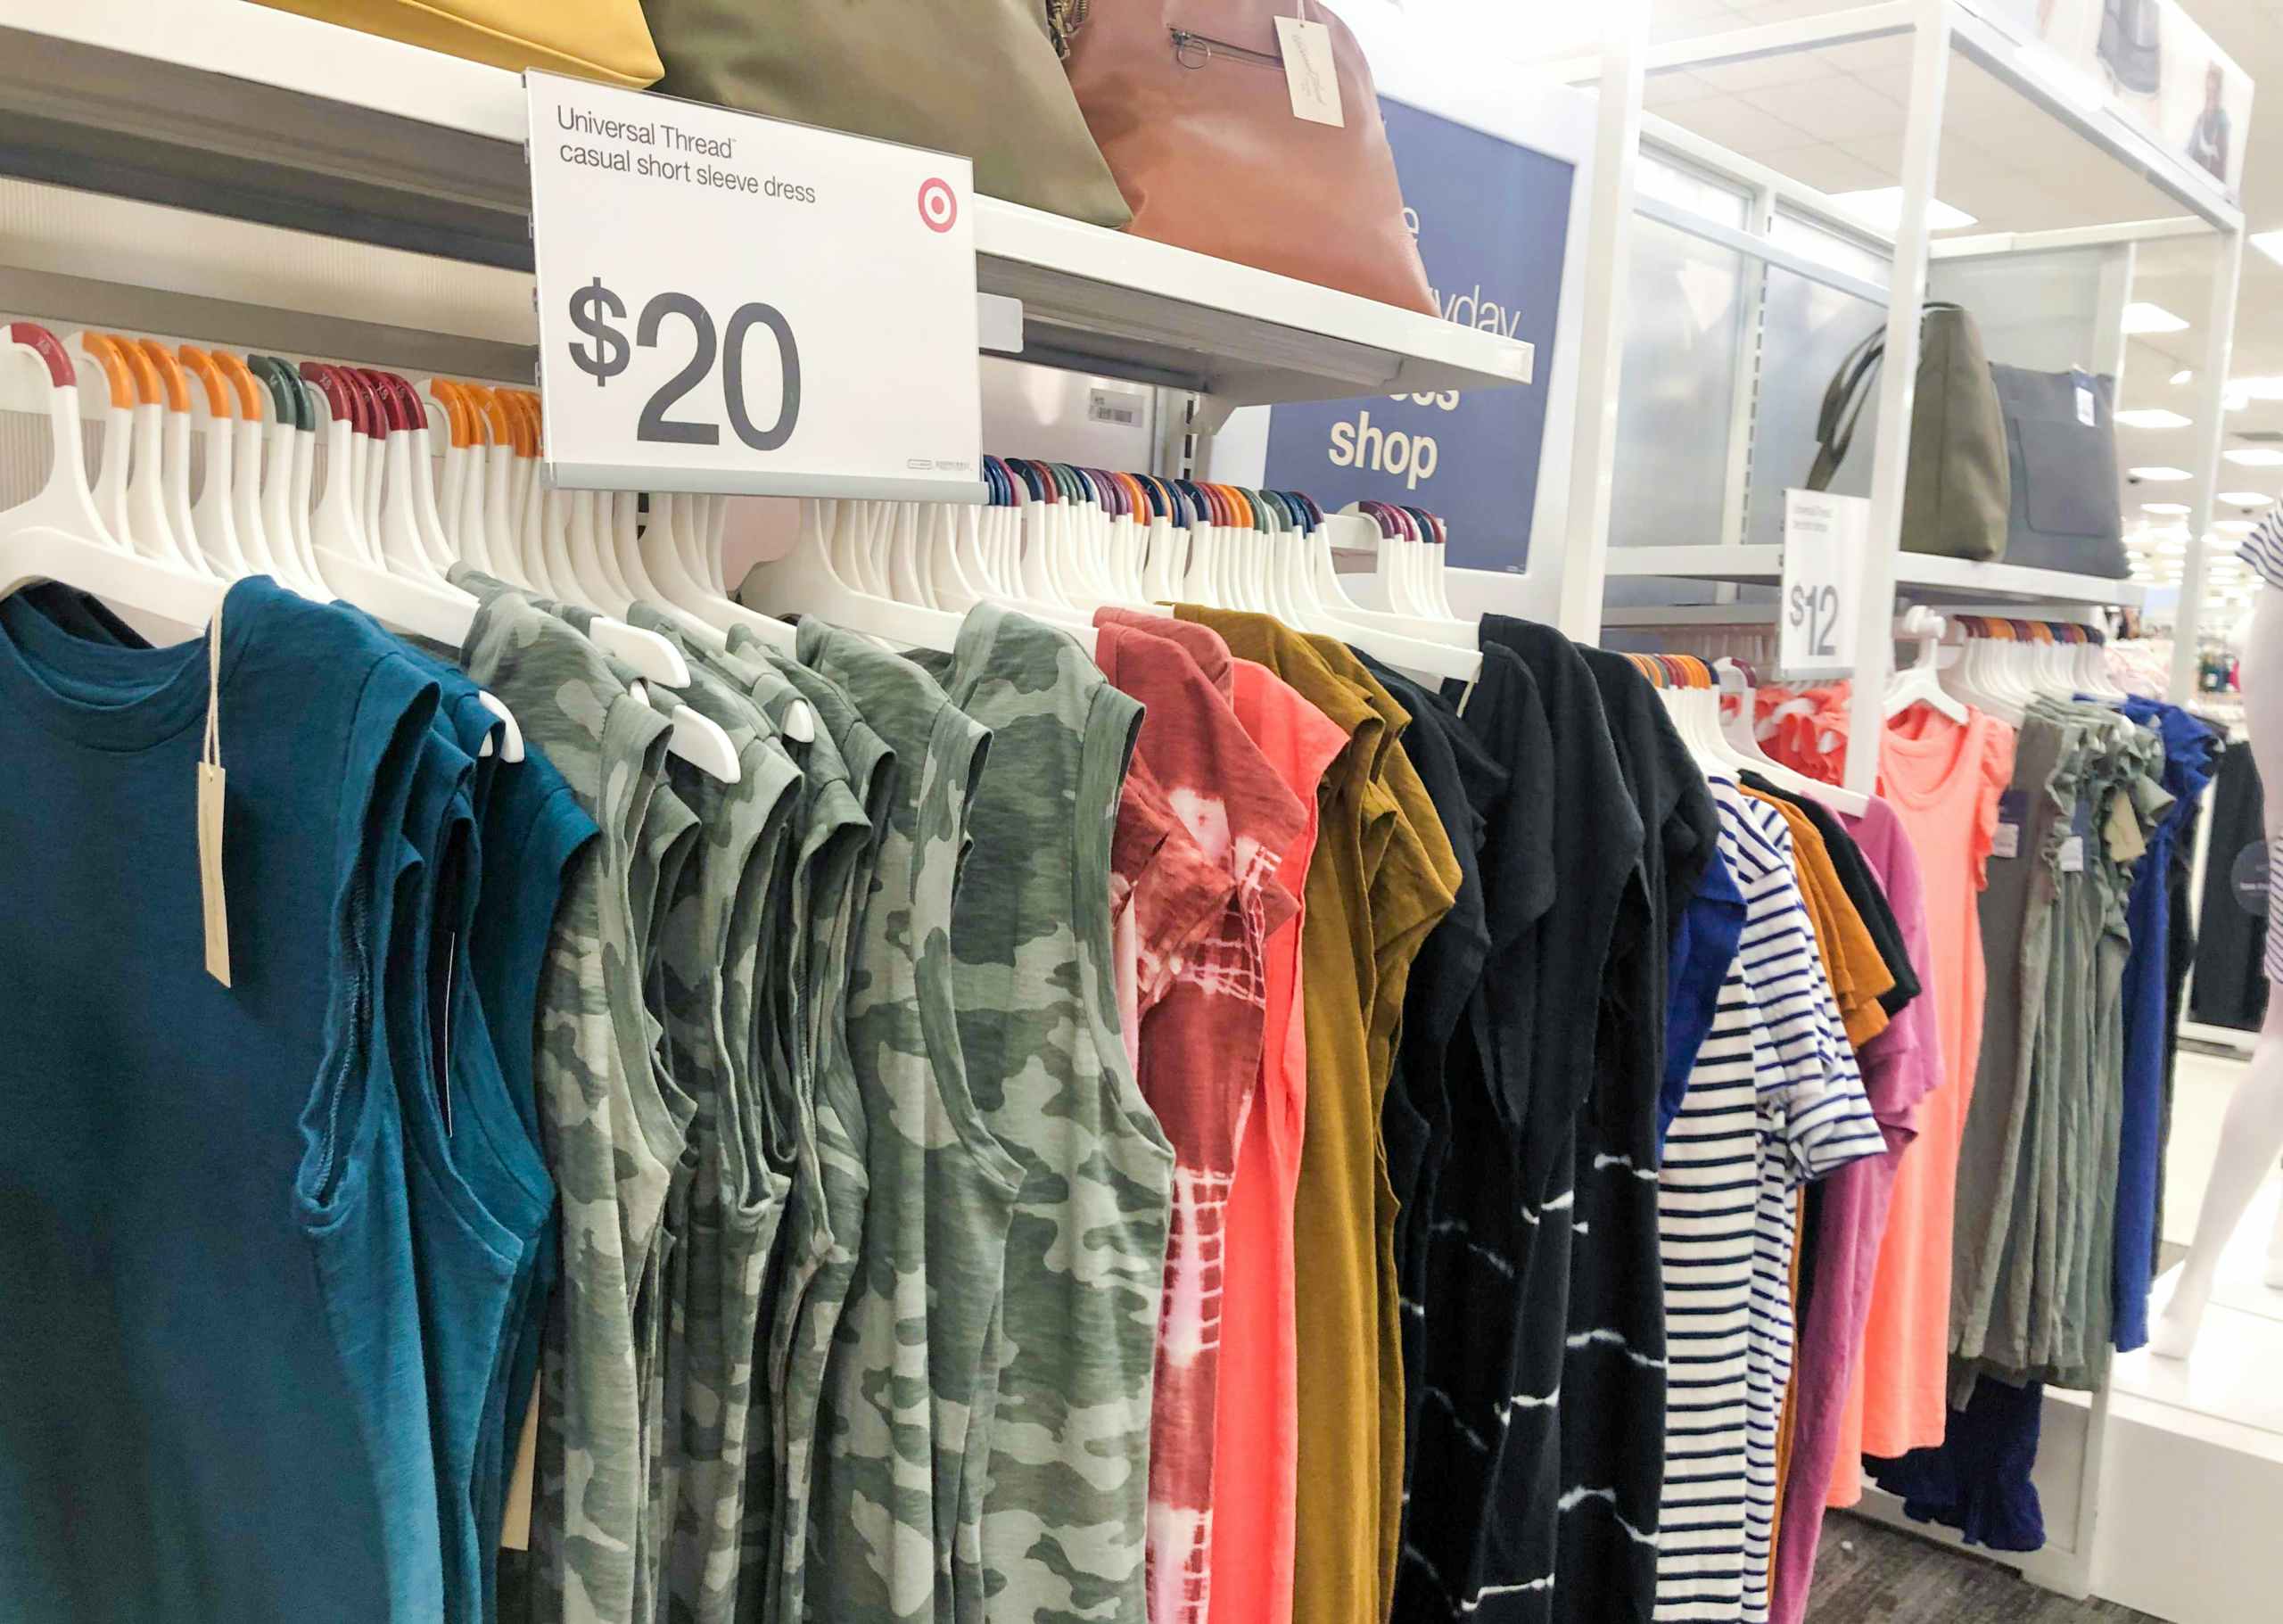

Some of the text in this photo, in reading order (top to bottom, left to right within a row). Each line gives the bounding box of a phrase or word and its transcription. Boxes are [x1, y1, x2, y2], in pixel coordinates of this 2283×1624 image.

[556, 104, 732, 159] Universal Thread
[559, 144, 816, 203] casual short sleeve dress
[1427, 284, 1521, 338] yday
[568, 276, 801, 451] $20
[1328, 409, 1438, 490] shop
[1790, 581, 1839, 656] $12
